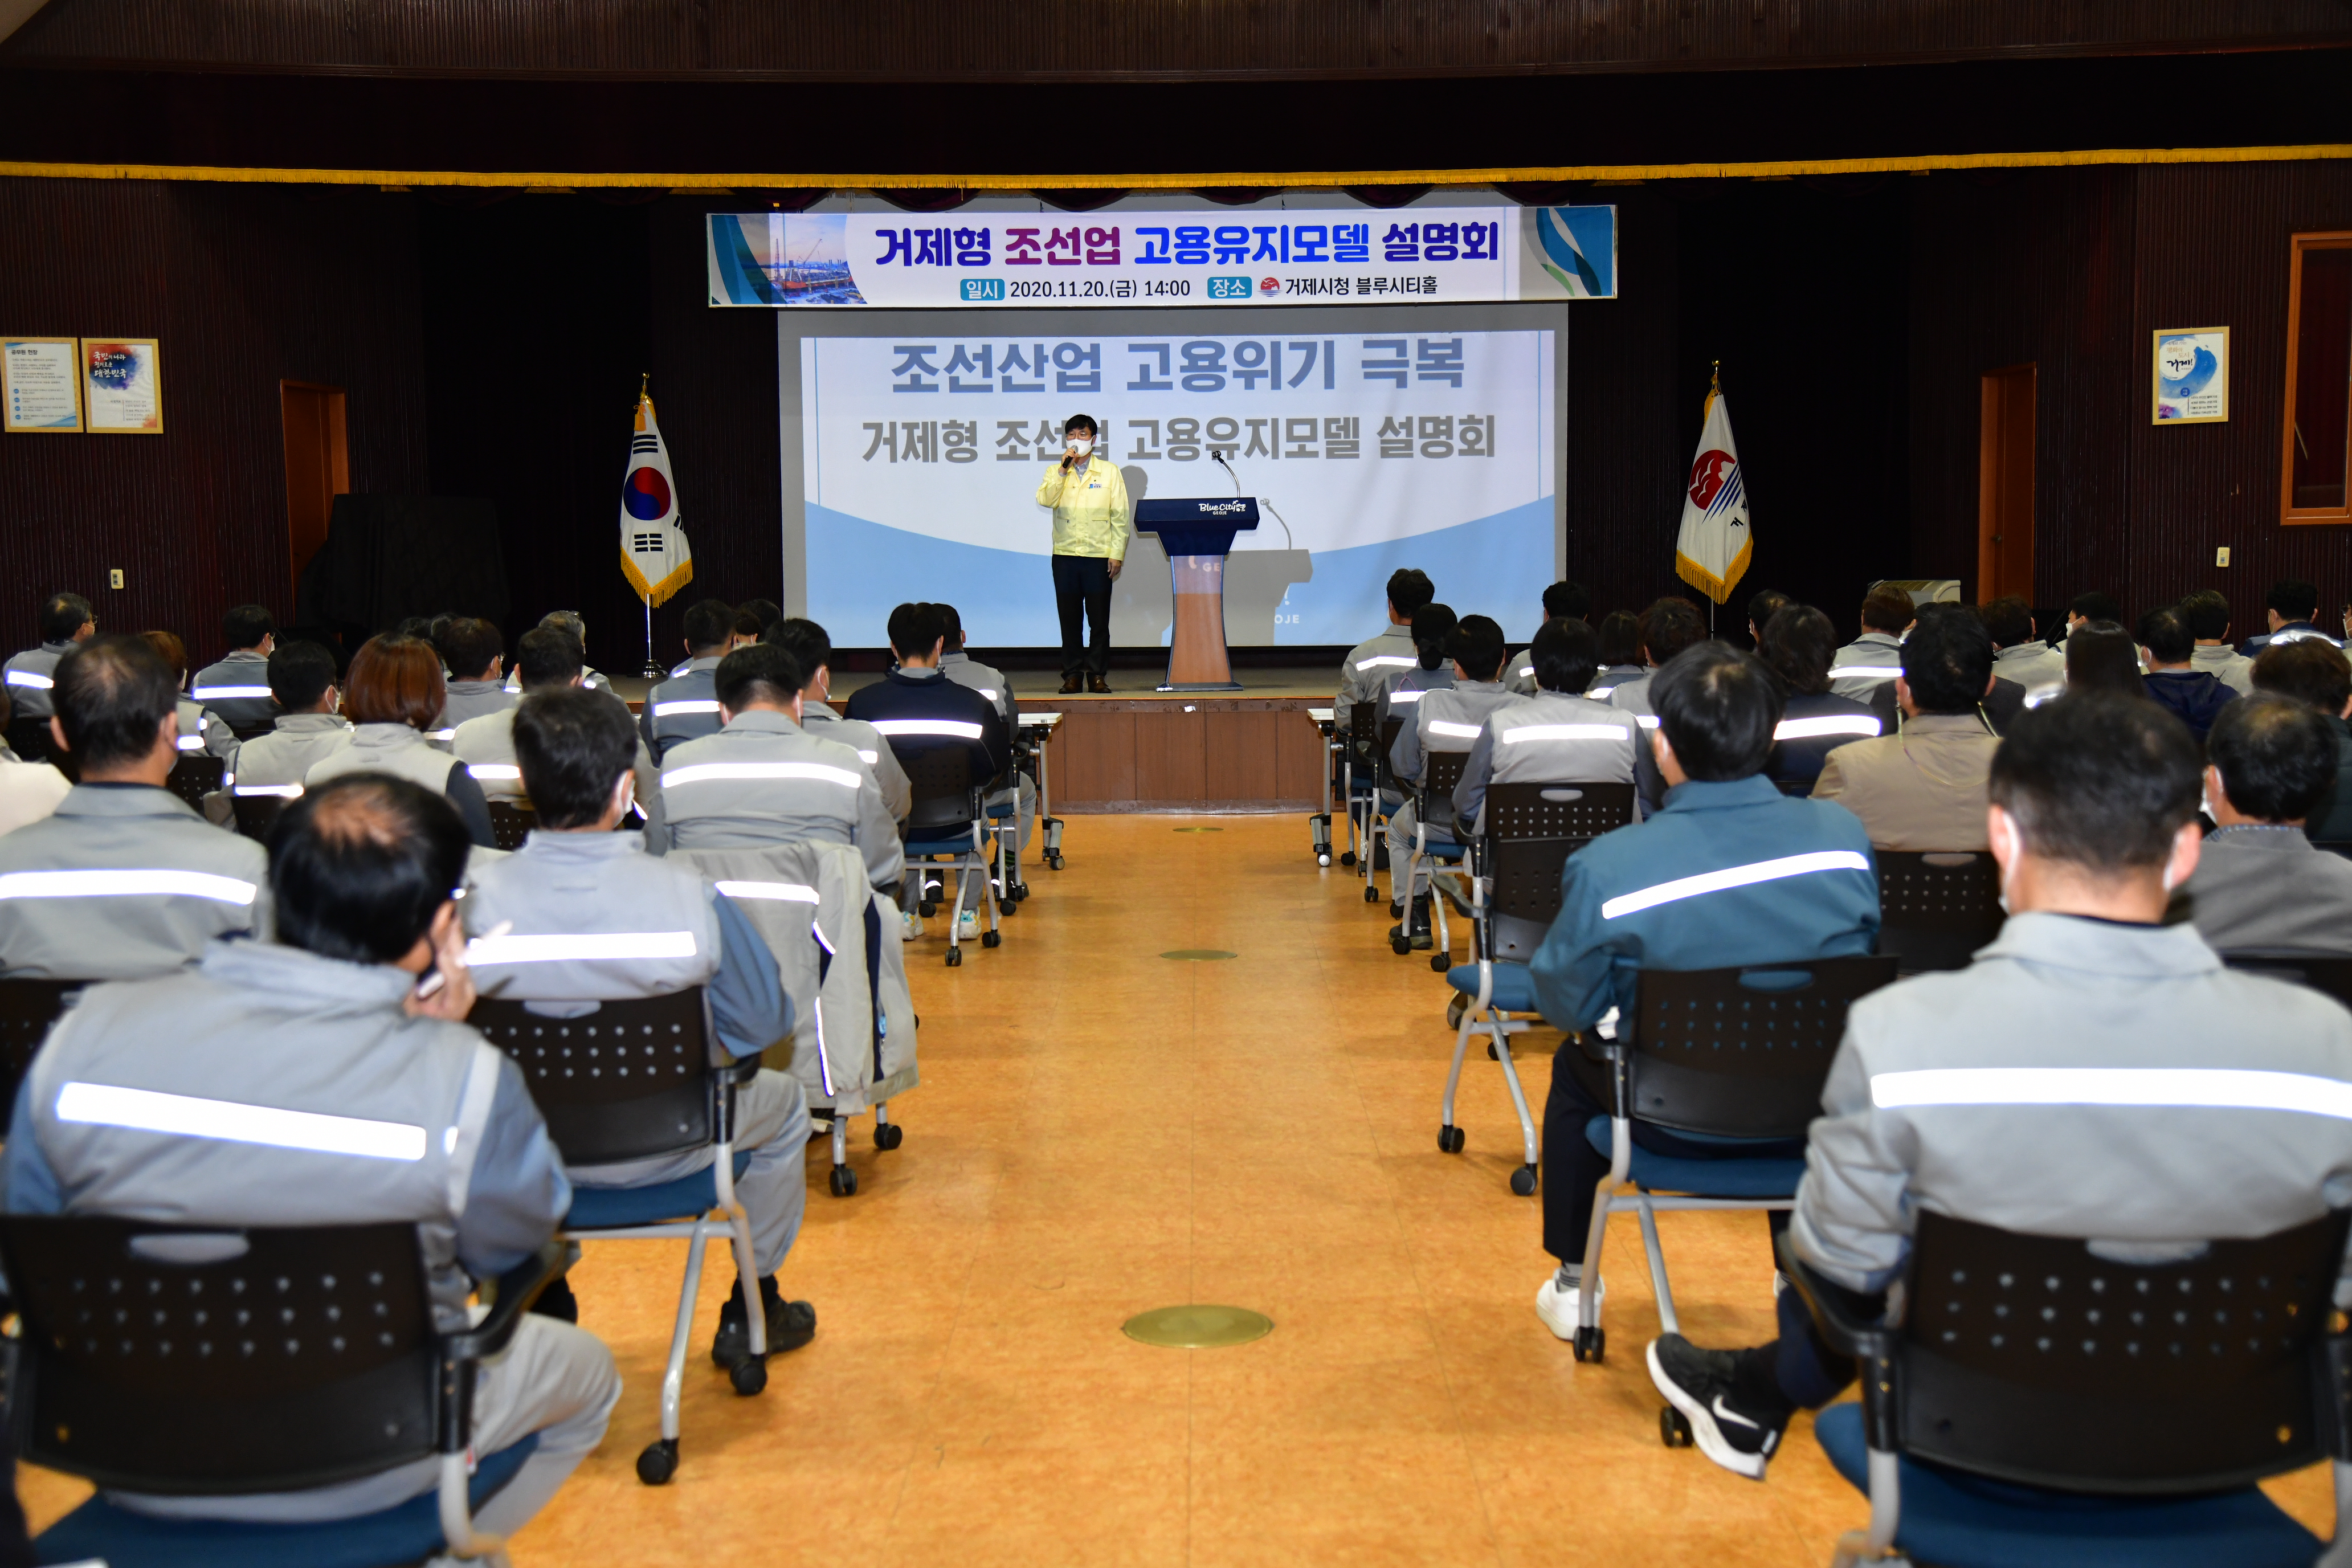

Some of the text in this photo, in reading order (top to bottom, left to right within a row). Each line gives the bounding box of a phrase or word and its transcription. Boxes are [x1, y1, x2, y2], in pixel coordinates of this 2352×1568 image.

[876, 222, 1498, 267] 거제형 조선업 고용유지모델 설명회
[966, 276, 1438, 299] 일시 2020.11.20.(금) 14:00 장소 거제시청 블루시티홀
[93, 351, 113, 361] 국민의
[891, 338, 1464, 393] 조선산업 고용위기 극복
[94, 368, 127, 379] 대한민국
[862, 419, 978, 463] 거제형
[1128, 416, 1360, 462] 고용유지모델
[1377, 414, 1495, 459] 설명회
[1198, 503, 1236, 512] Blue City
